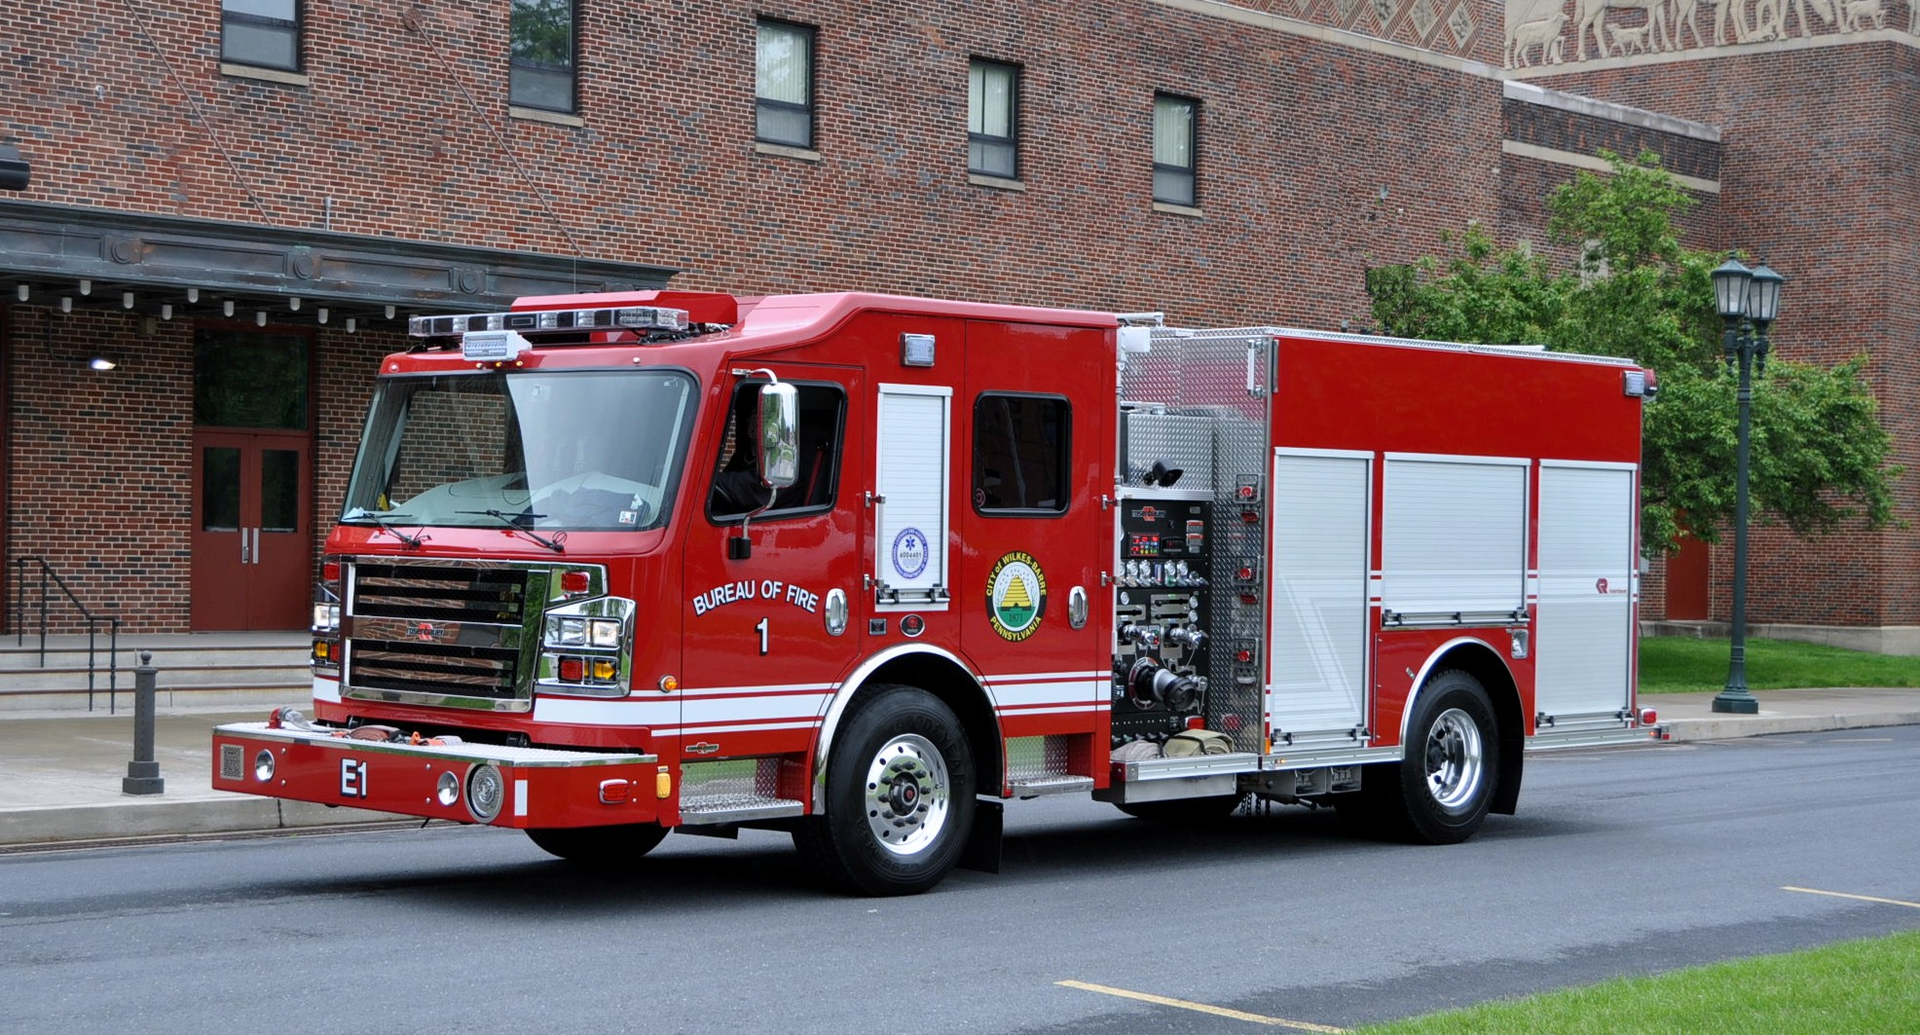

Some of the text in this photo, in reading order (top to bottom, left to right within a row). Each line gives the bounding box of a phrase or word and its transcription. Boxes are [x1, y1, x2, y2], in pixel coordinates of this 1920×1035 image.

[986, 552, 1046, 596] CITY of WILKES-BARRE
[693, 579, 819, 615] BUREAU OF FIRE
[756, 617, 768, 654] 1
[990, 616, 1041, 641] PENNSYLVANIA
[1009, 613, 1023, 622] 1871
[341, 758, 367, 797] E1
